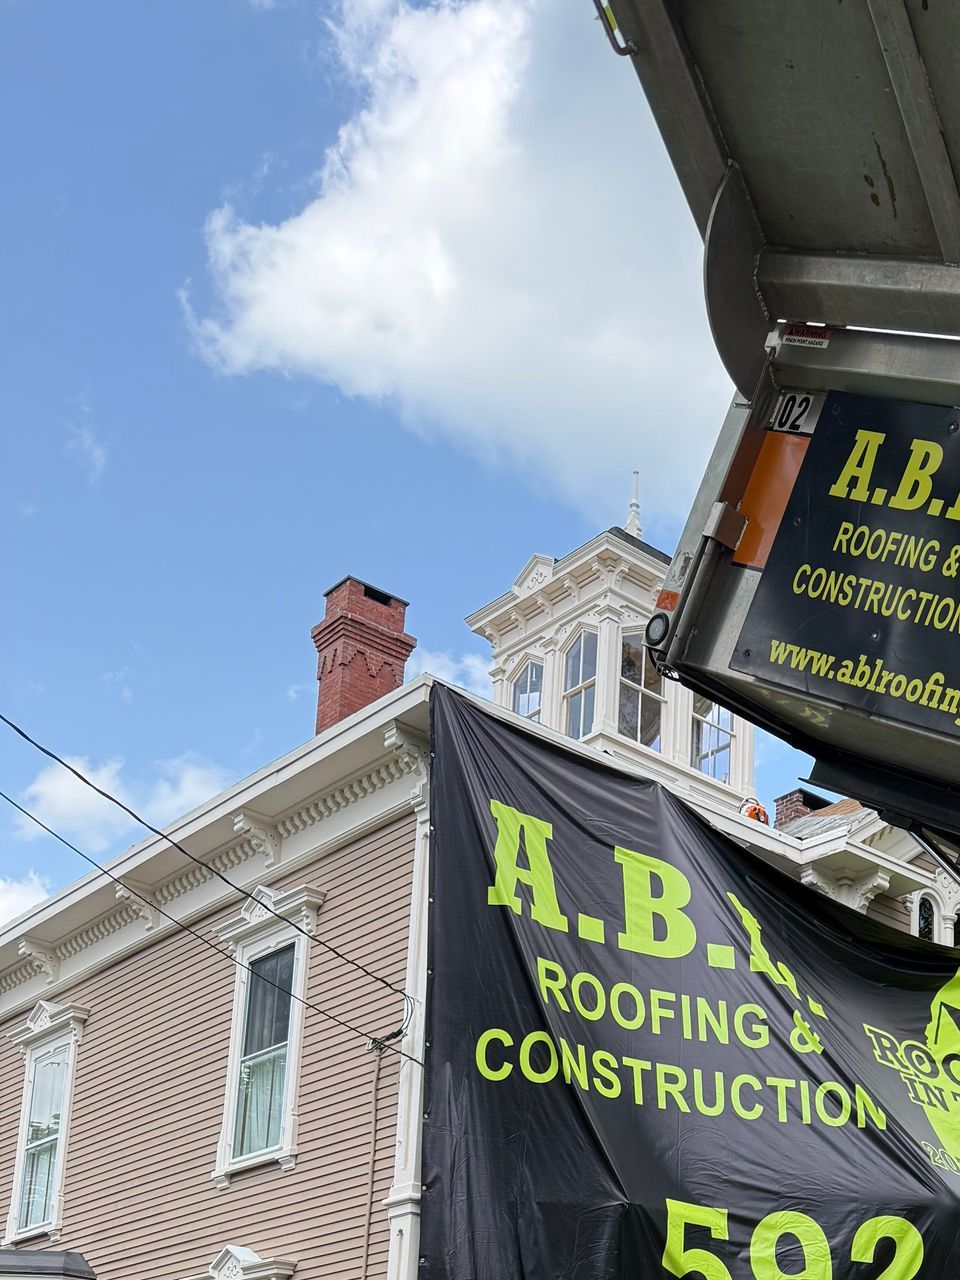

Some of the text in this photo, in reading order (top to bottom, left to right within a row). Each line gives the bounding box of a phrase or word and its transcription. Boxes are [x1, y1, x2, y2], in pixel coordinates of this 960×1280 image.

[833, 522, 940, 574] ROOFING
[536, 957, 825, 1055] ROOFING &
[475, 1028, 887, 1130] CONSTRUCTION
[901, 1073, 949, 1109] IN
